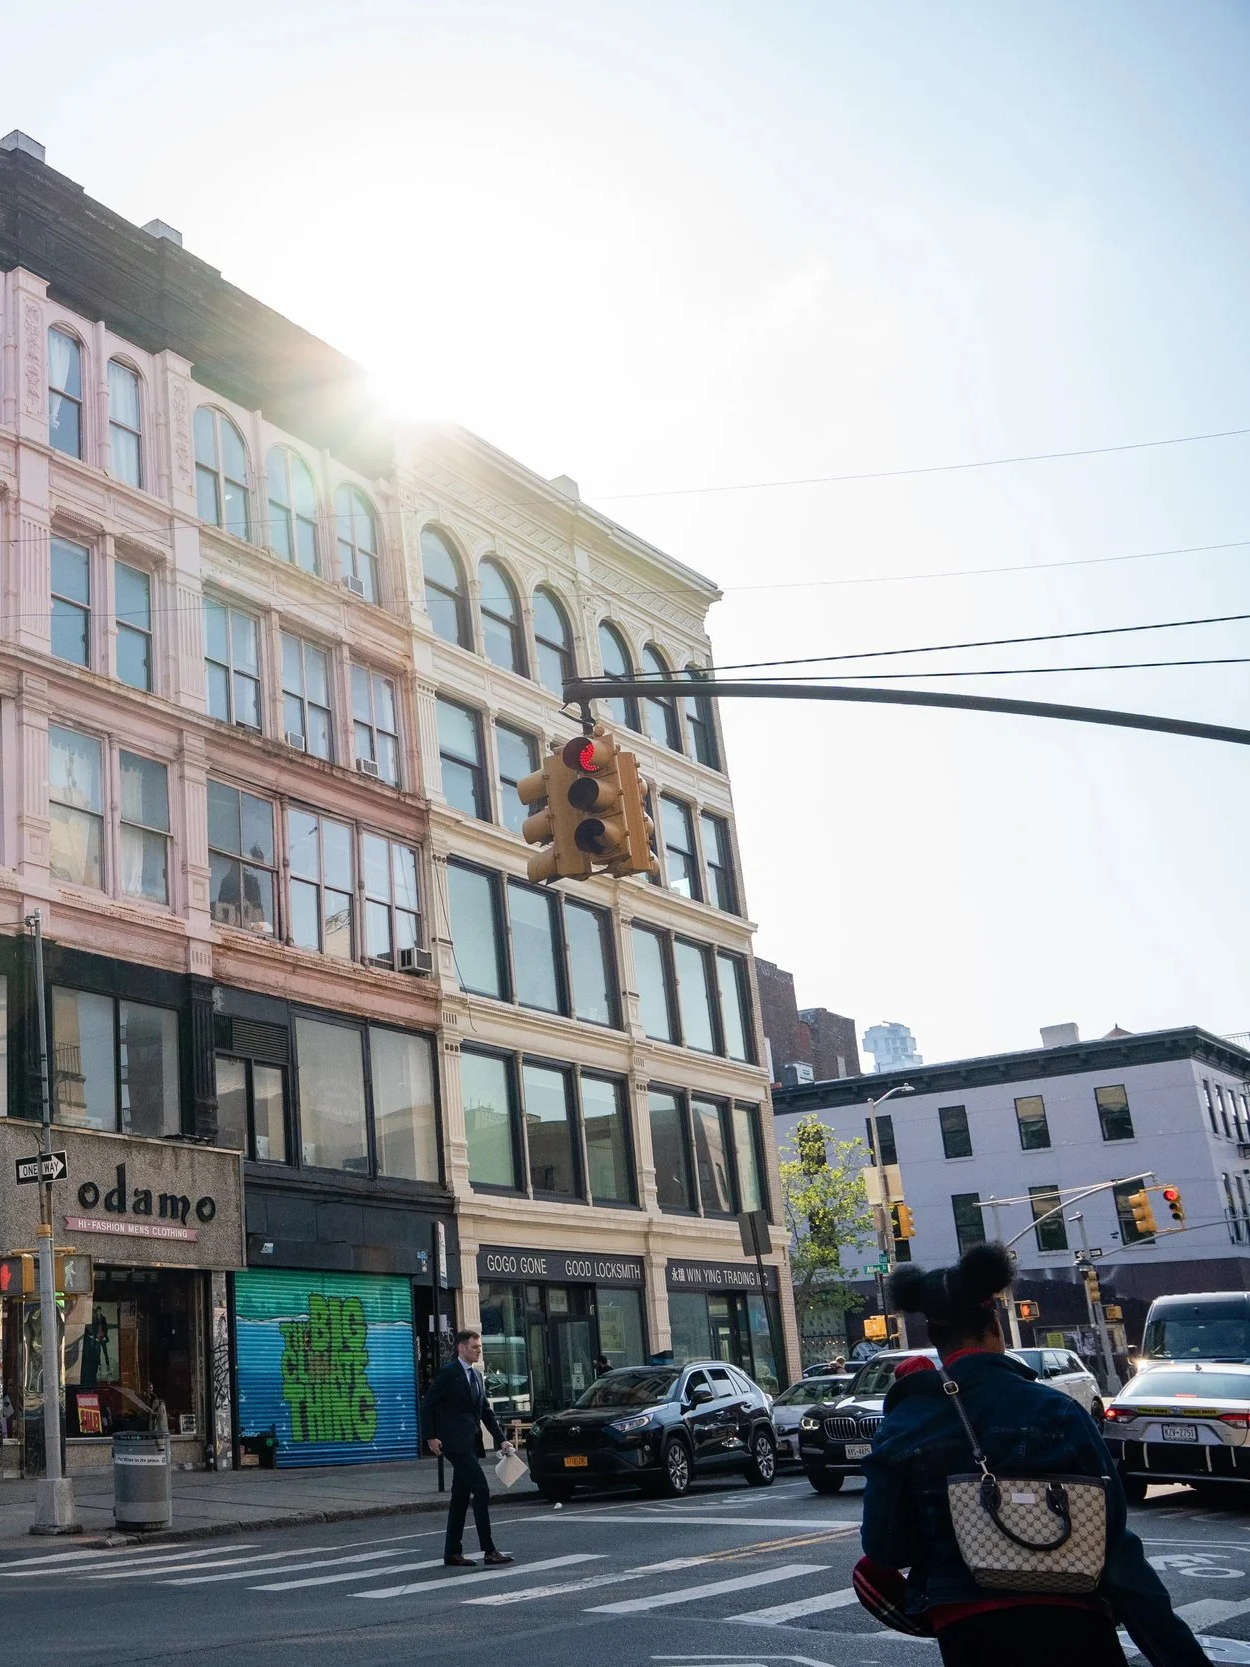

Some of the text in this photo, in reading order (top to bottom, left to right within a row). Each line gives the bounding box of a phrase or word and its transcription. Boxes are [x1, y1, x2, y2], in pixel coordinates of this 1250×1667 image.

[22, 1160, 60, 1177] ONE WAY
[77, 1162, 217, 1226] odamo
[78, 1219, 188, 1239] HI-FASHION MENS CLOTHING
[486, 1255, 547, 1275] GOGO GONE
[565, 1260, 641, 1280] GOOD LOCKSMITH
[686, 1268, 702, 1282] WIN
[703, 1269, 722, 1284] YING
[723, 1270, 755, 1286] TRADING
[307, 1293, 368, 1351] BIG
[283, 1382, 377, 1442] THING
